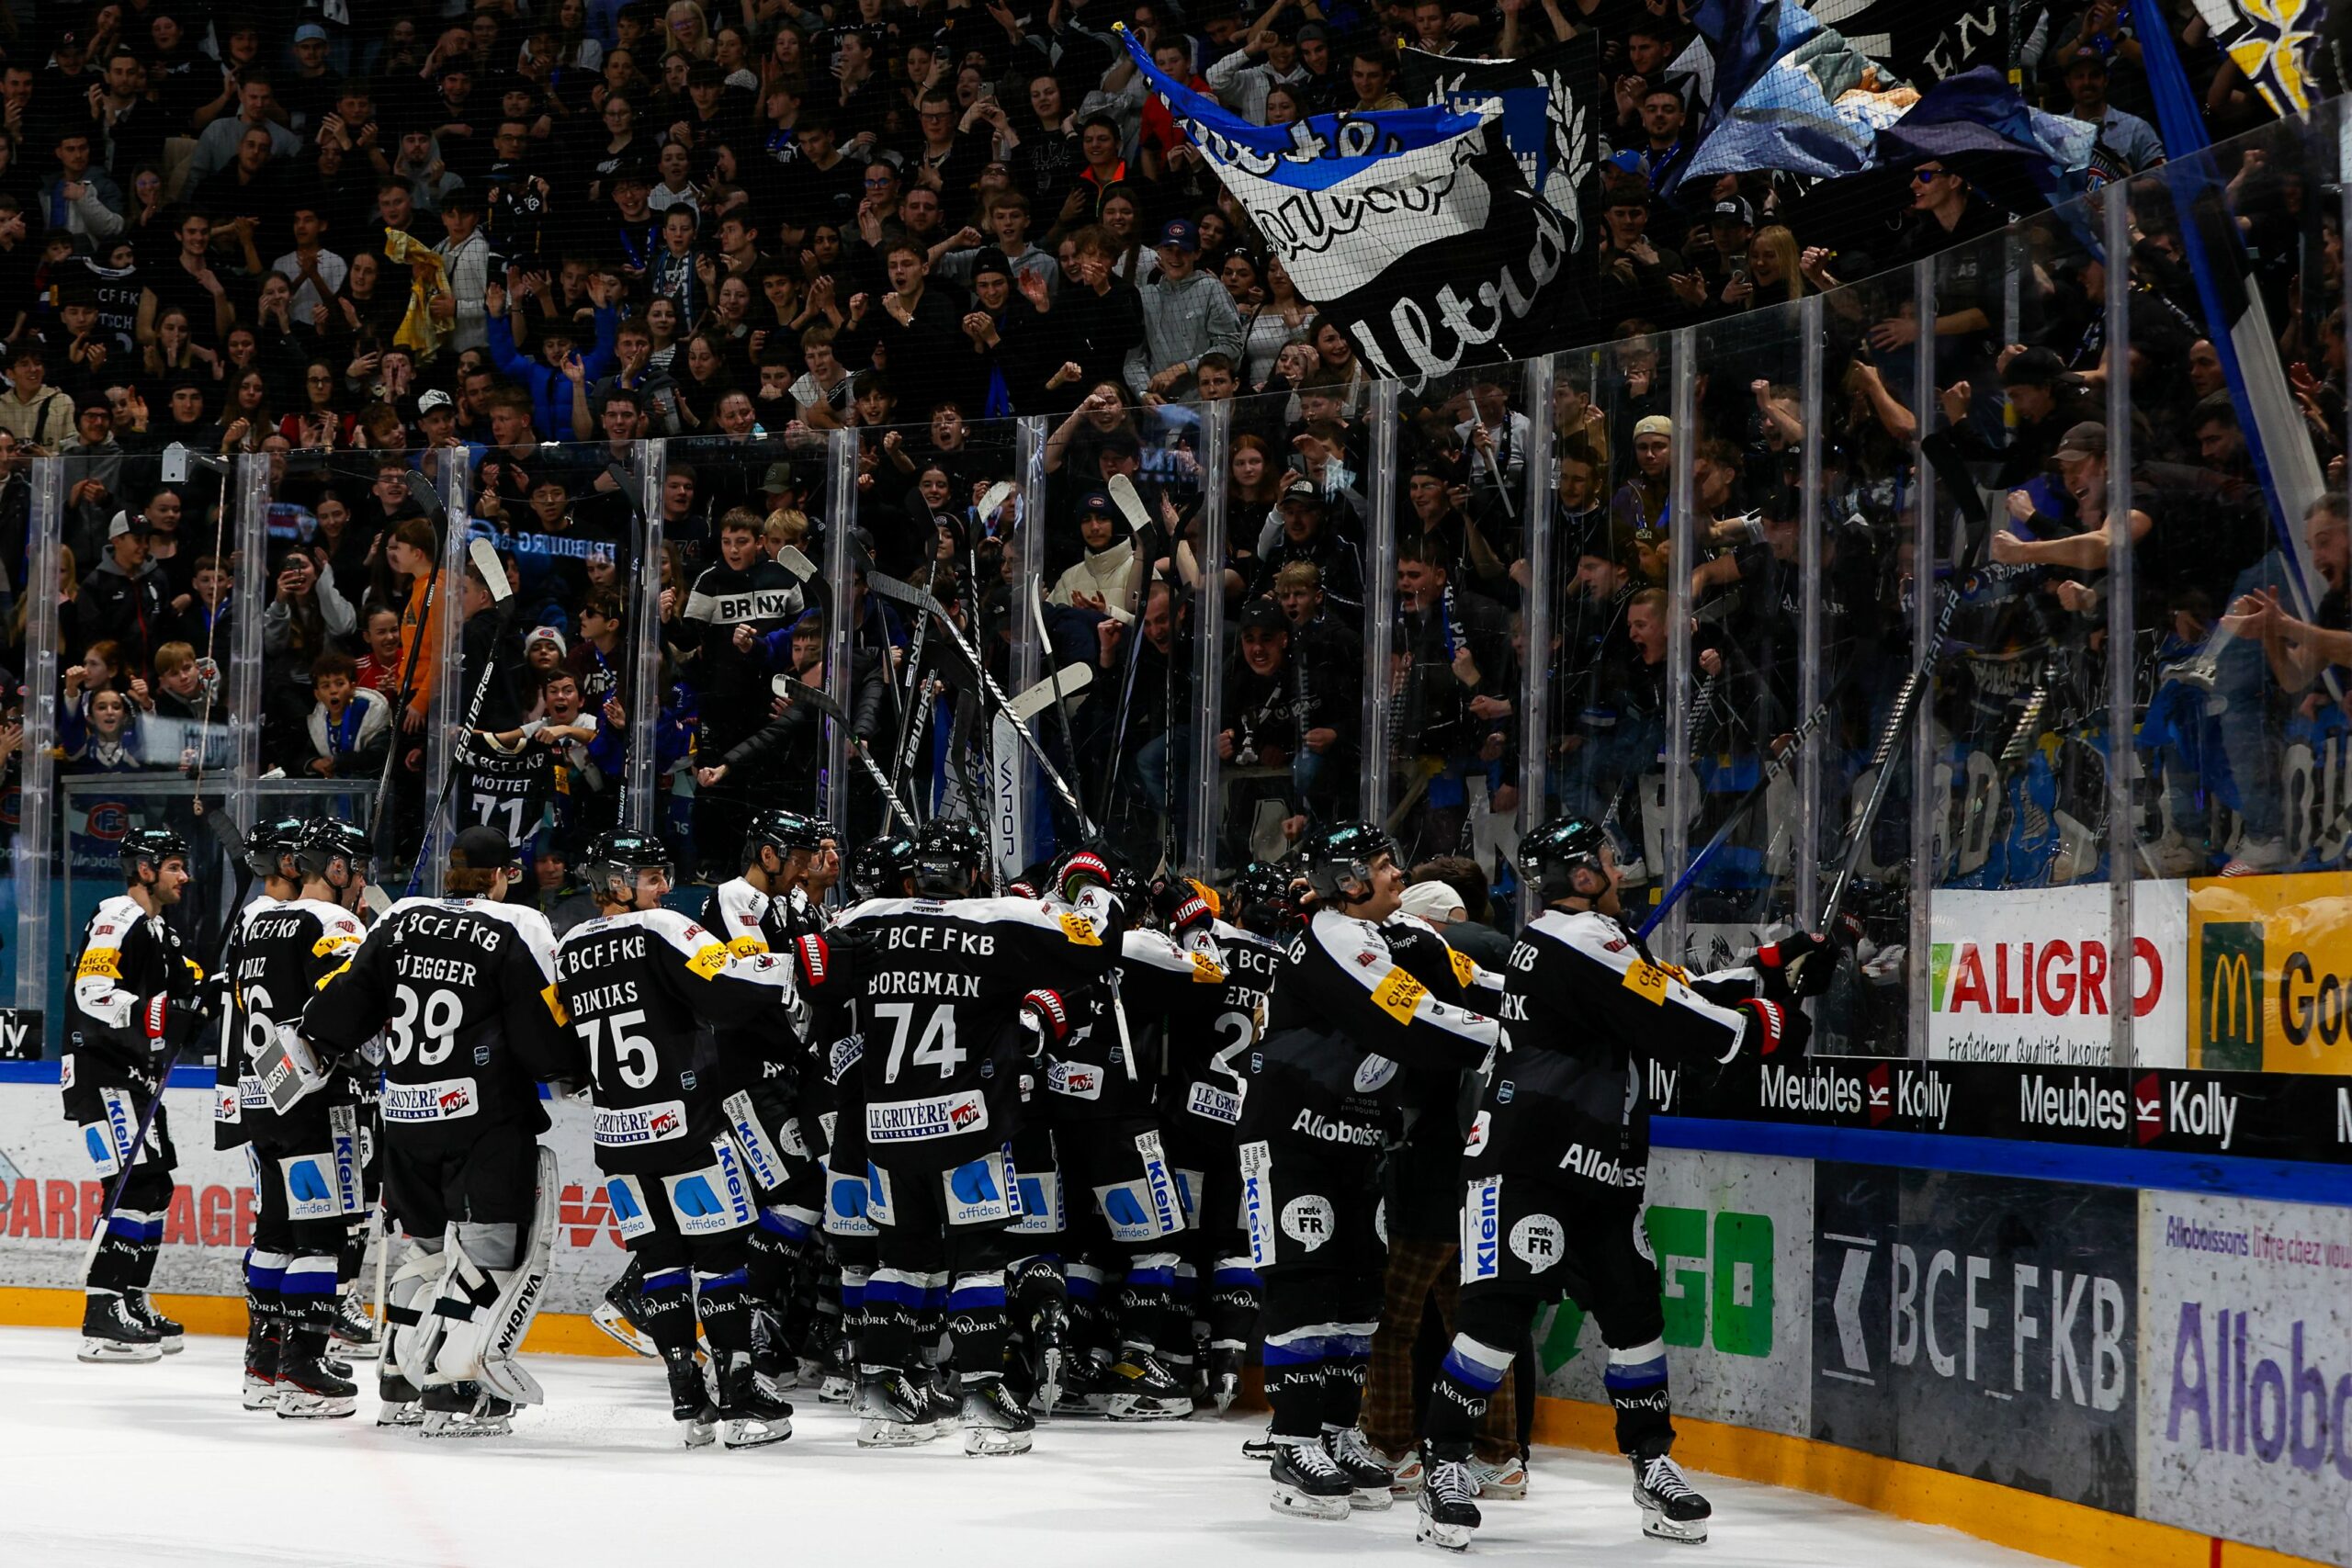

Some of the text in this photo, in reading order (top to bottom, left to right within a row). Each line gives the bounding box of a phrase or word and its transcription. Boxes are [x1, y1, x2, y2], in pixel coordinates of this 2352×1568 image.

[455, 682, 489, 763] BAUER
[904, 691, 931, 766] BAUER
[472, 794, 524, 848] 71
[1000, 756, 1016, 858] VAPOR
[952, 843, 961, 852] 74
[1330, 829, 1358, 844] SWICA
[871, 867, 880, 875] 18
[1527, 857, 1538, 866] 32
[867, 970, 982, 998] BORGMAN
[1949, 935, 2165, 1017] ALIGRO
[571, 980, 639, 1018] BINIAS
[386, 983, 464, 1066] 39
[874, 1001, 967, 1085] 74
[575, 1009, 659, 1090] 75
[443, 1093, 469, 1117] AOP
[869, 1102, 949, 1129] LE GRUYÈRE
[1761, 1064, 1861, 1114] Meubles
[1898, 1069, 1951, 1130] Kolly
[2020, 1073, 2128, 1132] Meubles
[2169, 1080, 2237, 1150] Kolly
[653, 1112, 679, 1138] AOP
[873, 1124, 946, 1139] SWITZERLAND
[953, 1107, 981, 1128] AOP
[335, 1136, 356, 1210] Klein
[736, 1121, 775, 1187] Klein
[717, 1145, 750, 1224] Klein
[1147, 1160, 1175, 1232] Klein
[294, 1201, 333, 1215] affidea
[685, 1216, 728, 1232] affidea
[958, 1204, 1001, 1220] affidea
[1245, 1177, 1264, 1264] Klein
[1297, 1205, 1322, 1215] net+
[1299, 1217, 1324, 1234] FR
[619, 1220, 646, 1235] ffidea
[1116, 1225, 1150, 1238] affidea
[1476, 1186, 1497, 1277] Klein
[1529, 1225, 1554, 1237] net+
[2165, 1214, 2249, 1258] Alloboissons
[2253, 1225, 2286, 1262] livre
[2324, 1237, 2352, 1270] vou
[1528, 1237, 1554, 1257] FR
[496, 1273, 541, 1355] VAUGHN
[1890, 1242, 2128, 1414] BCF_FKB
